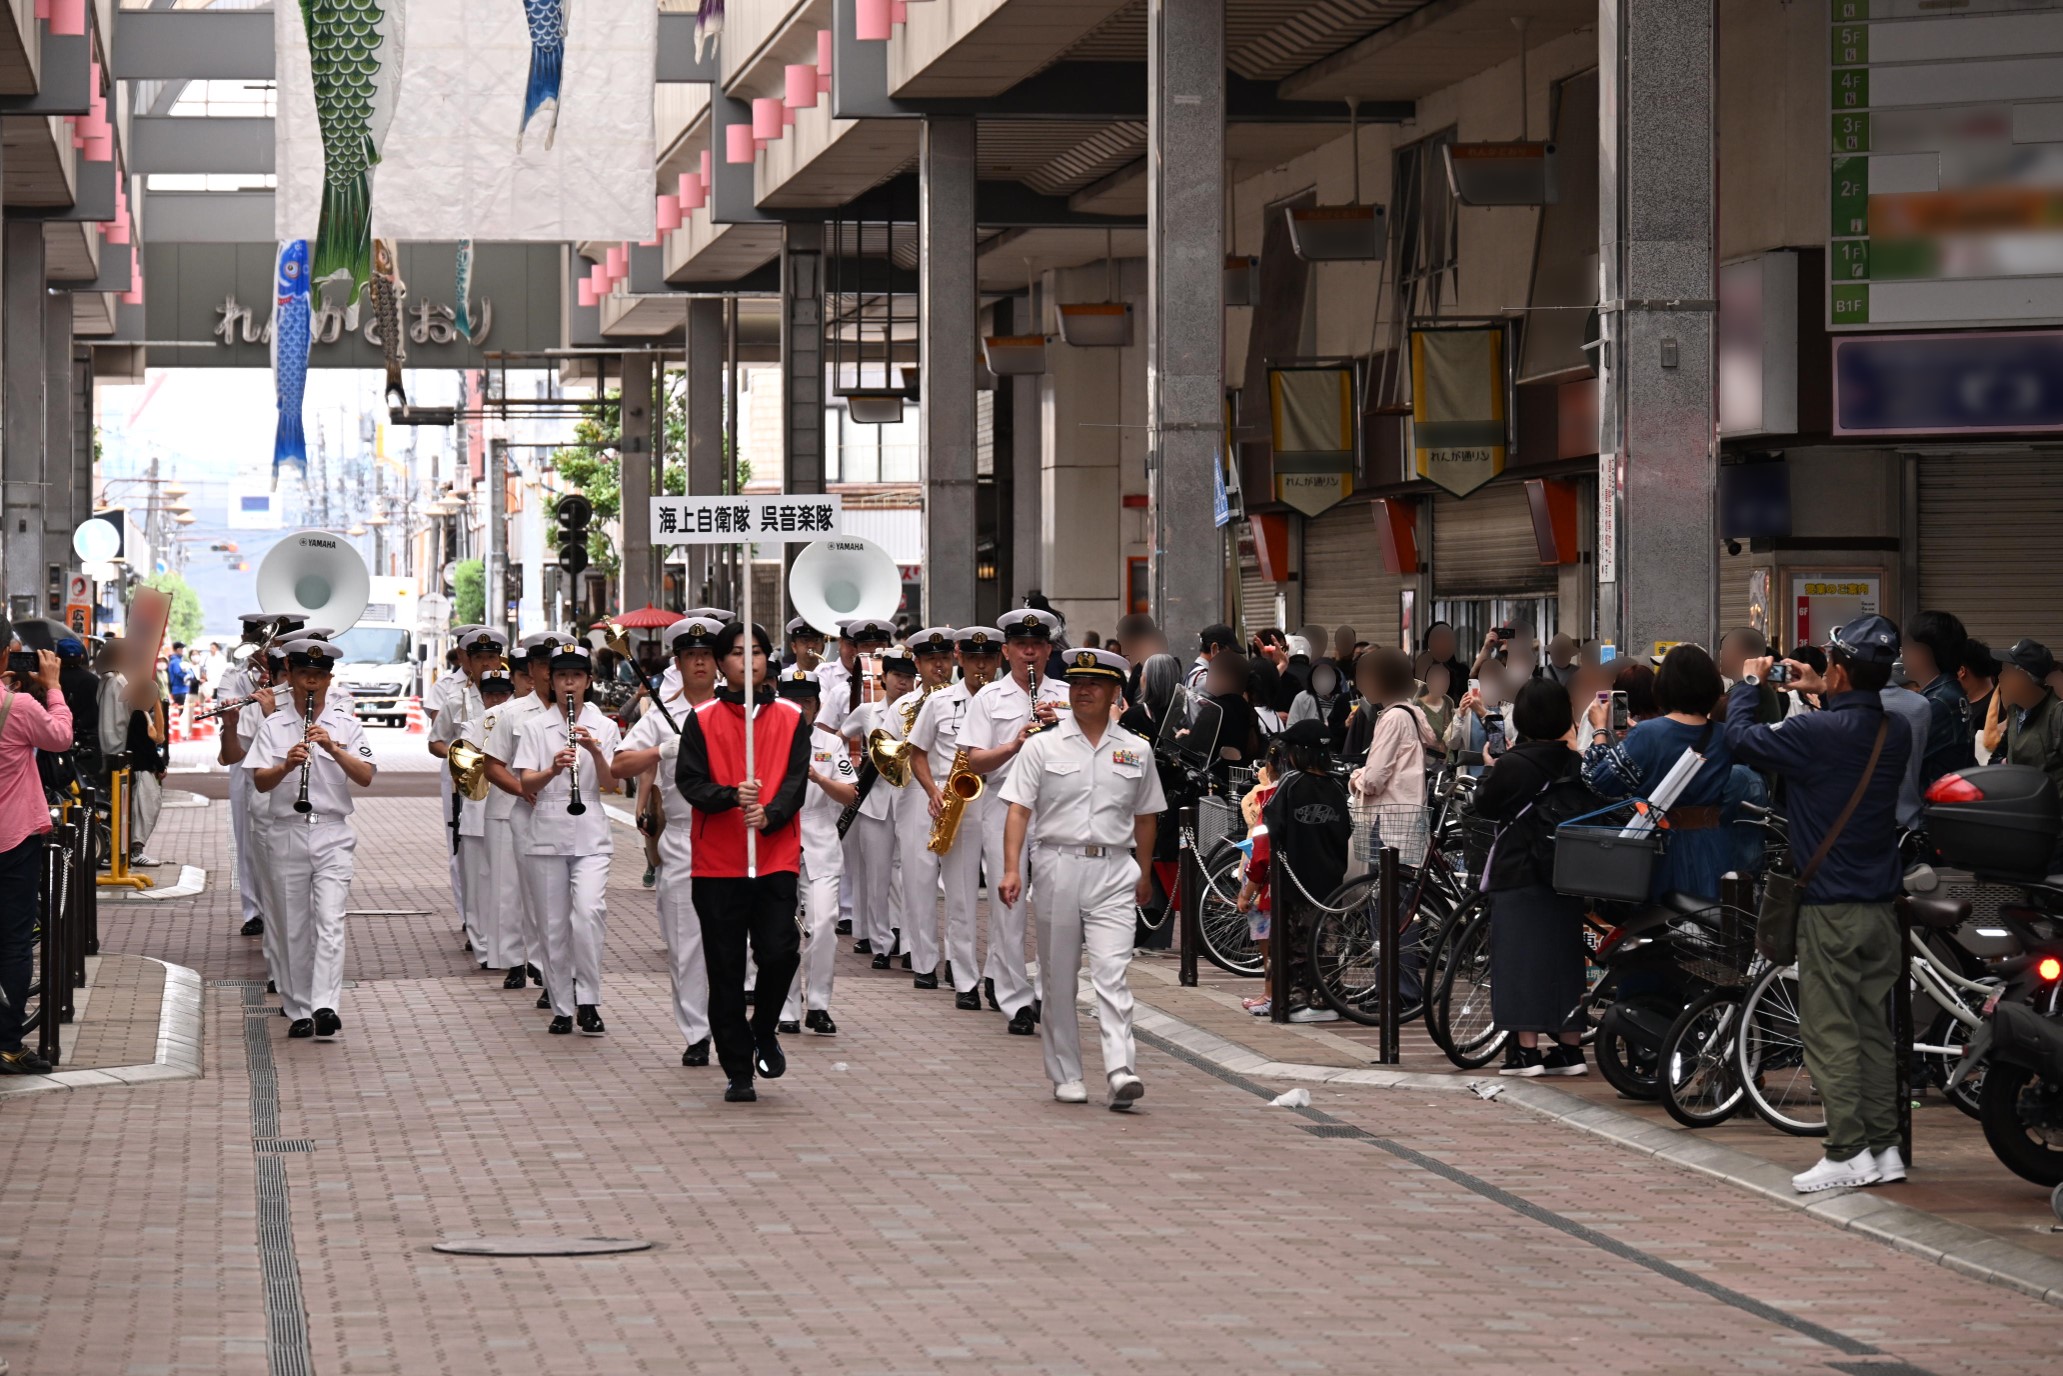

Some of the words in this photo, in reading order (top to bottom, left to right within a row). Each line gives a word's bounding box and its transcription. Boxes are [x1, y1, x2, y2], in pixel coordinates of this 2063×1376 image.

[1841, 28, 1861, 44] 5F
[1841, 73, 1861, 88] 4F
[1843, 117, 1862, 133] 3F
[1840, 180, 1860, 196] 2F
[1841, 244, 1860, 260] 1F
[1836, 300, 1862, 312] B1F
[214, 294, 491, 346] れがおり
[659, 505, 750, 534] 海上自衛隊
[760, 504, 834, 532] 呉音楽隊
[308, 539, 336, 549] YAMAHA
[836, 542, 864, 550] YAMAHA
[1799, 607, 1808, 616] 6F
